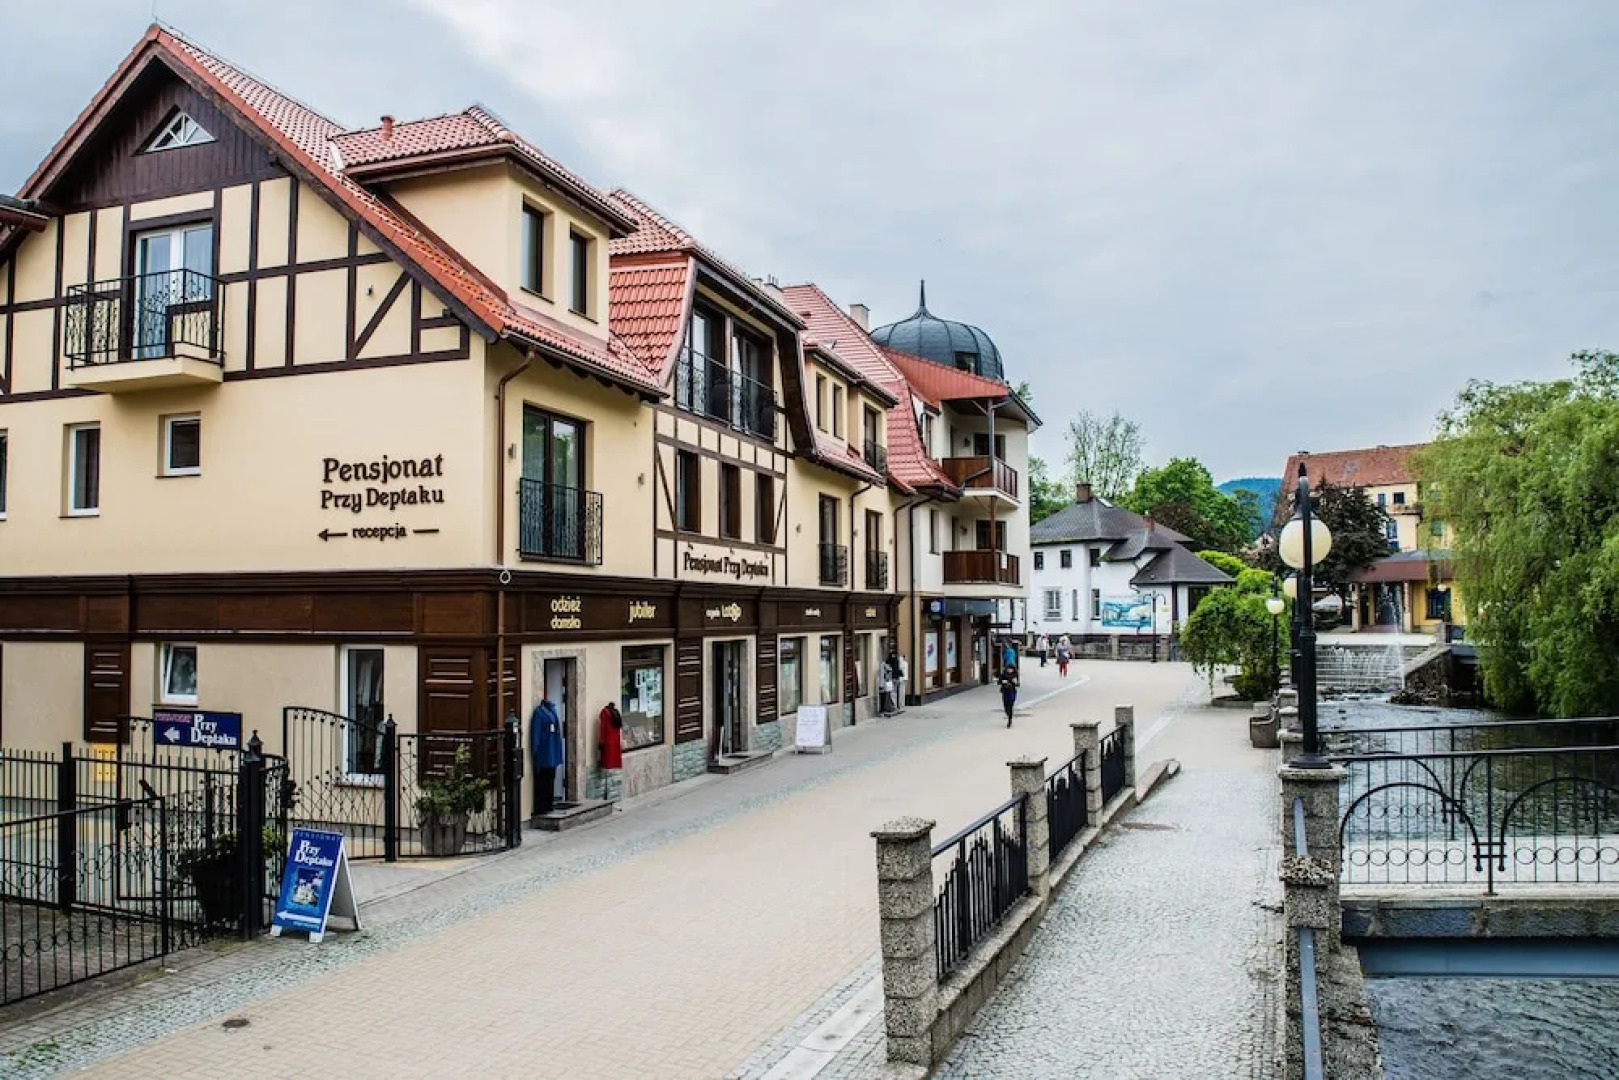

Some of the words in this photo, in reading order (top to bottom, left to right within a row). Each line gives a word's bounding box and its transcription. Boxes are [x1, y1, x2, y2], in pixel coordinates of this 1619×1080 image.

[322, 453, 443, 484] Pensjonat
[320, 489, 361, 513] Przy
[366, 484, 445, 510] Deptaku
[352, 522, 407, 541] recepcja
[724, 556, 740, 580] Przy
[628, 600, 656, 623] jubiler
[194, 713, 217, 734] Przy
[191, 726, 237, 747] Deptaku
[295, 849, 334, 867] Deptaku
[300, 839, 321, 857] Przy
